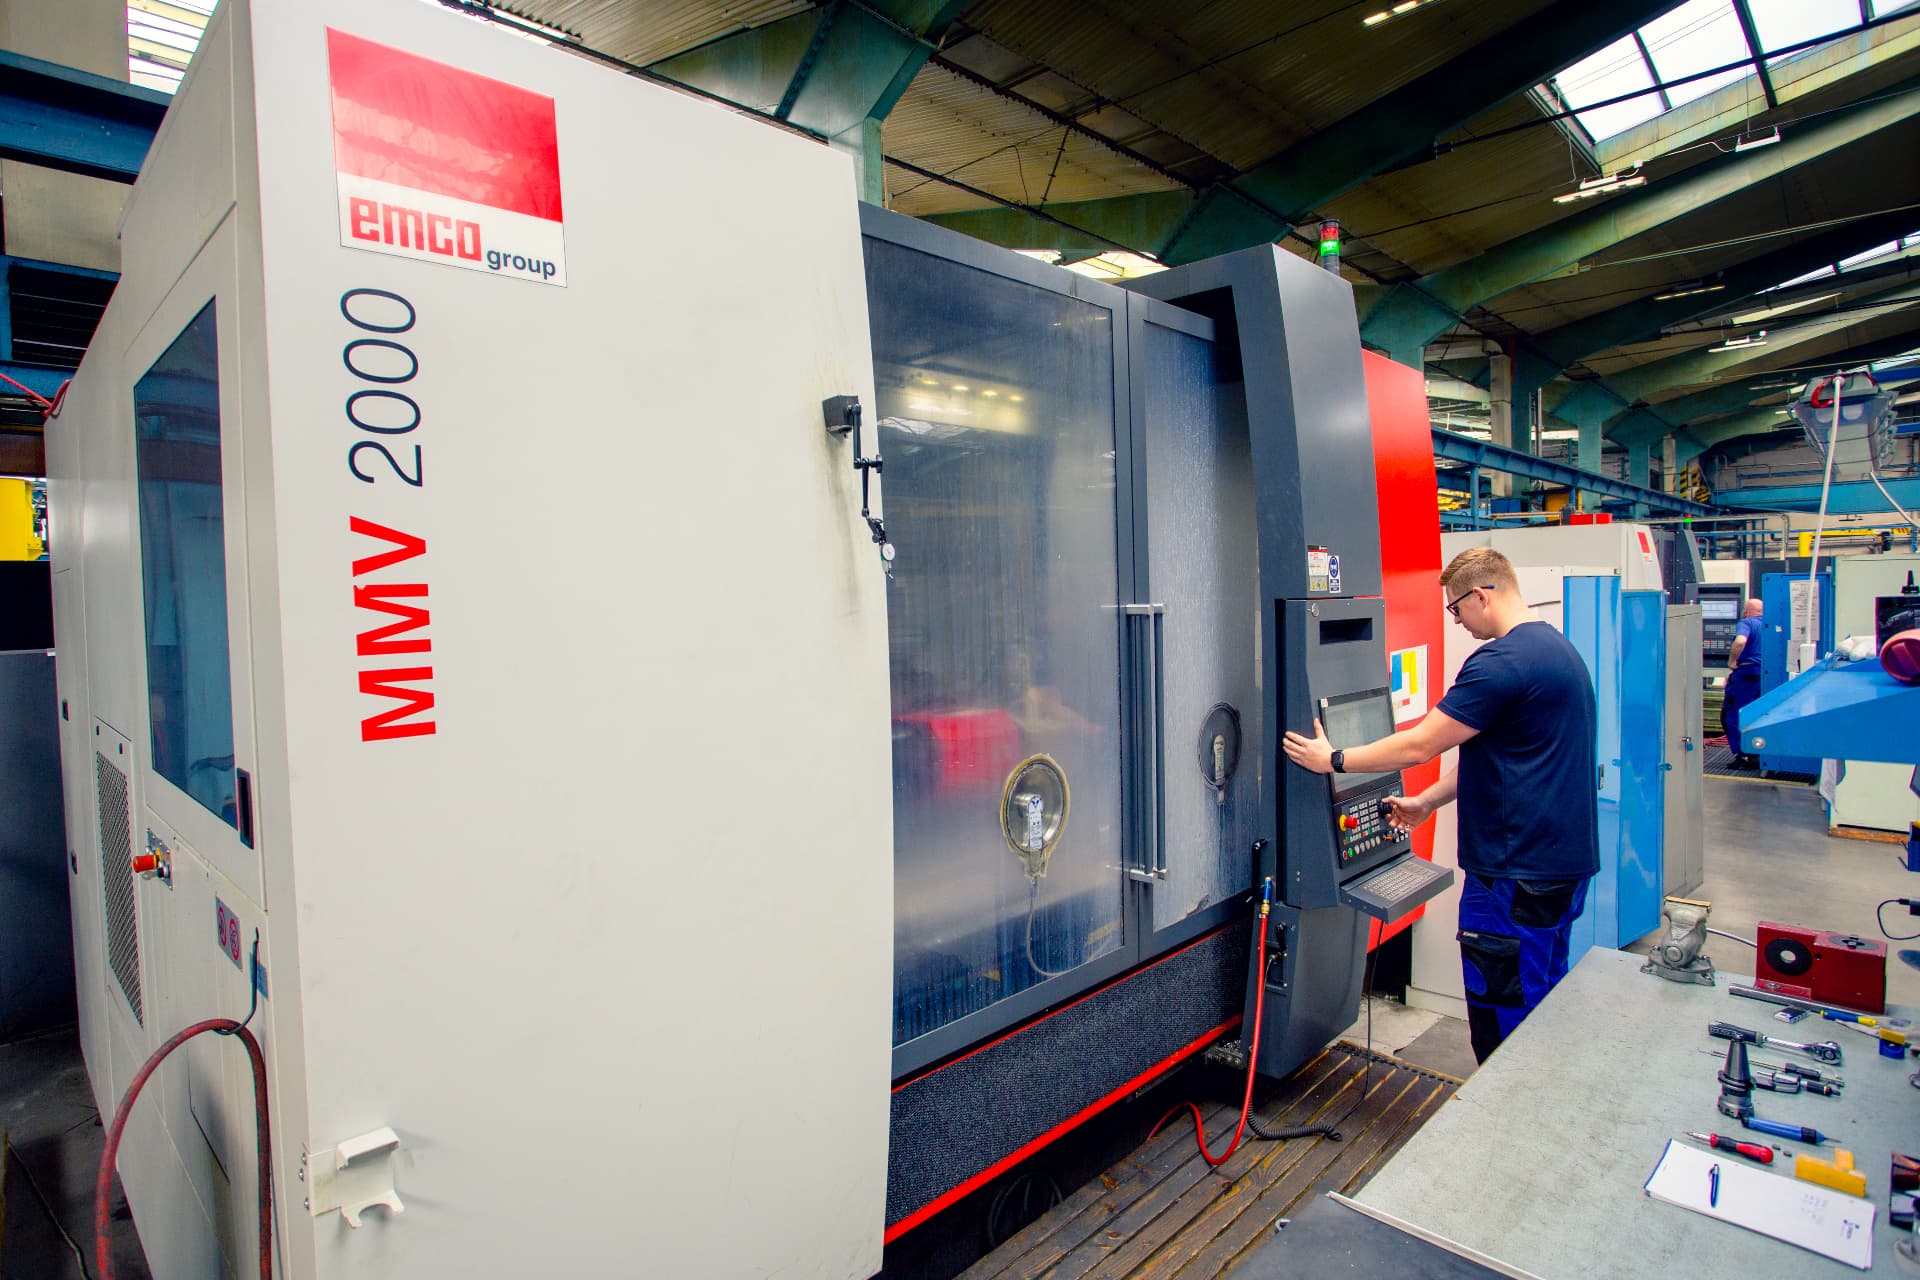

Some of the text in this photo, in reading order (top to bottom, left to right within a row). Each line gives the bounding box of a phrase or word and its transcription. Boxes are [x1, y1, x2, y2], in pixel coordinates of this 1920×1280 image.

[350, 196, 557, 280] emco group
[340, 287, 436, 742] MMV 2000
